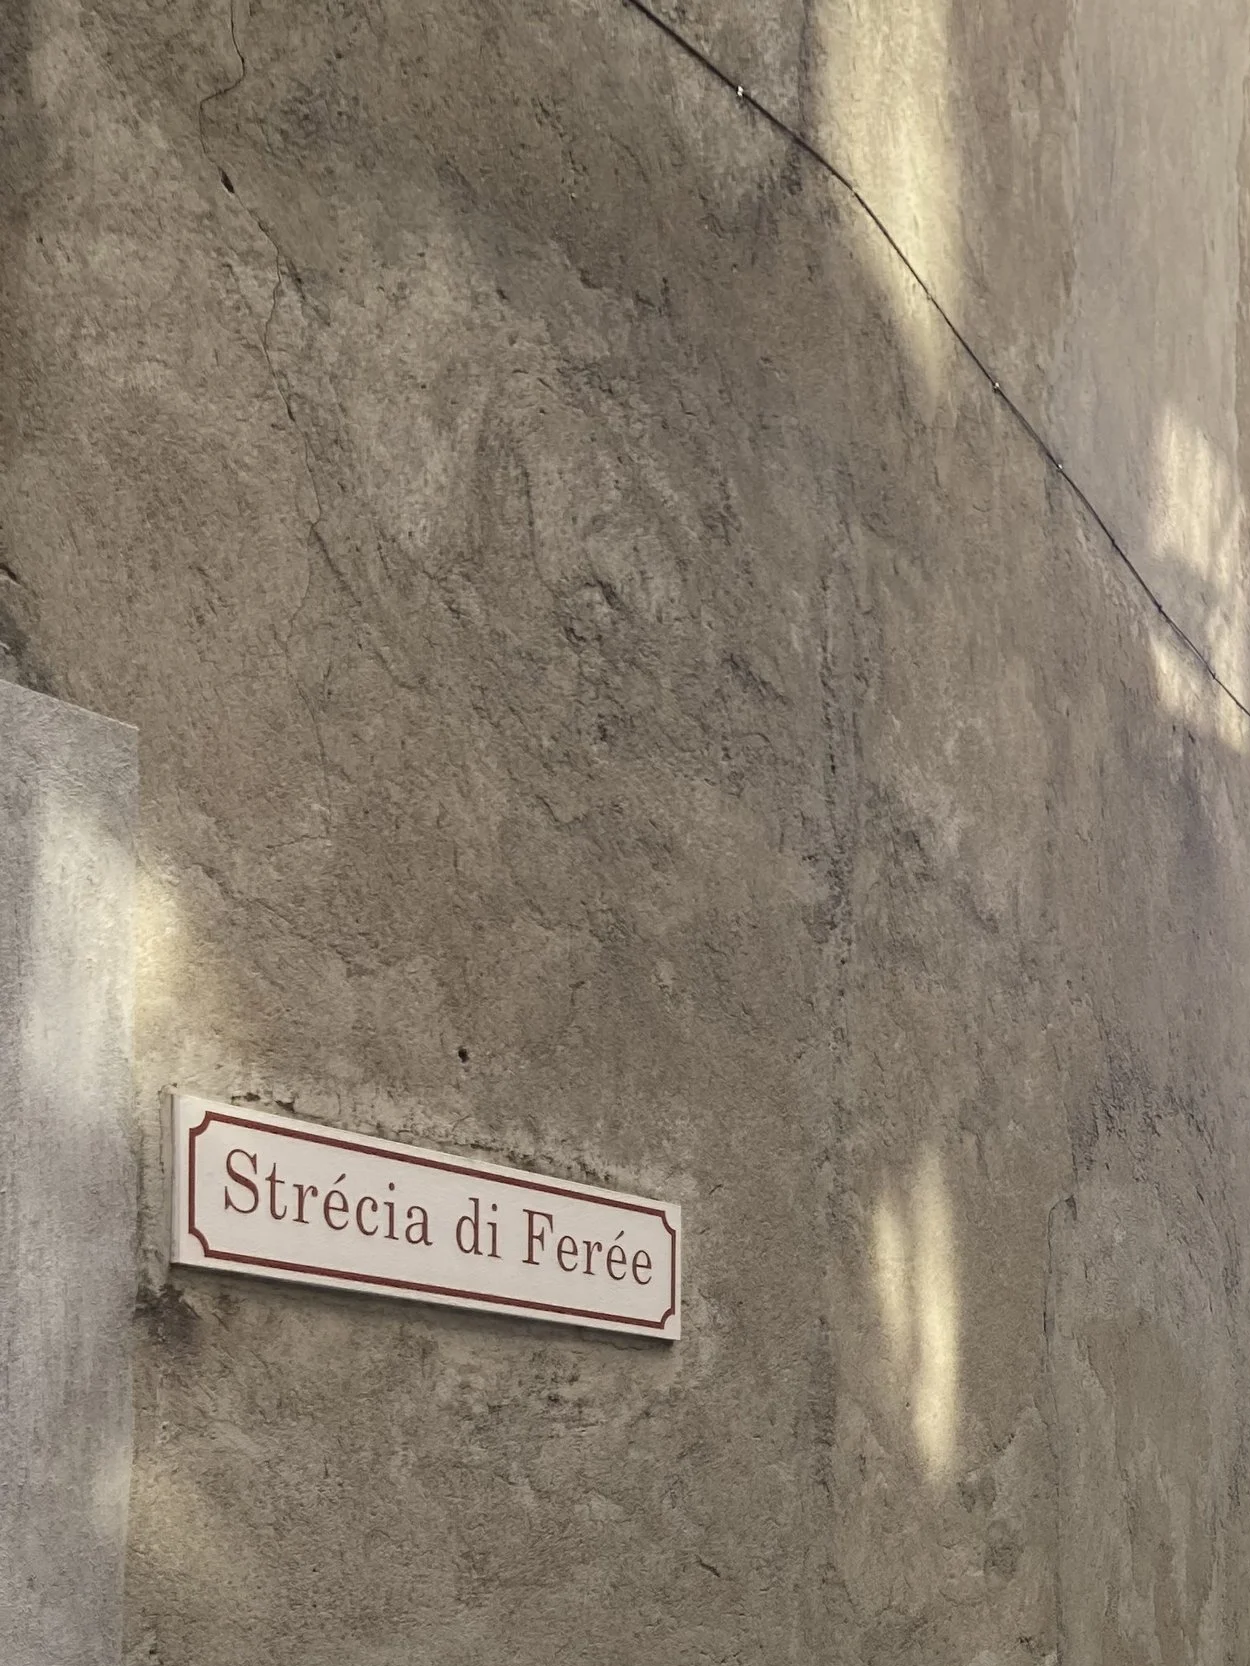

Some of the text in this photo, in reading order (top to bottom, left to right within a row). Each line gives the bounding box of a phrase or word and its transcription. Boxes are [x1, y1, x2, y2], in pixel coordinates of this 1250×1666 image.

[224, 1148, 653, 1286] Strécia di Ferée
